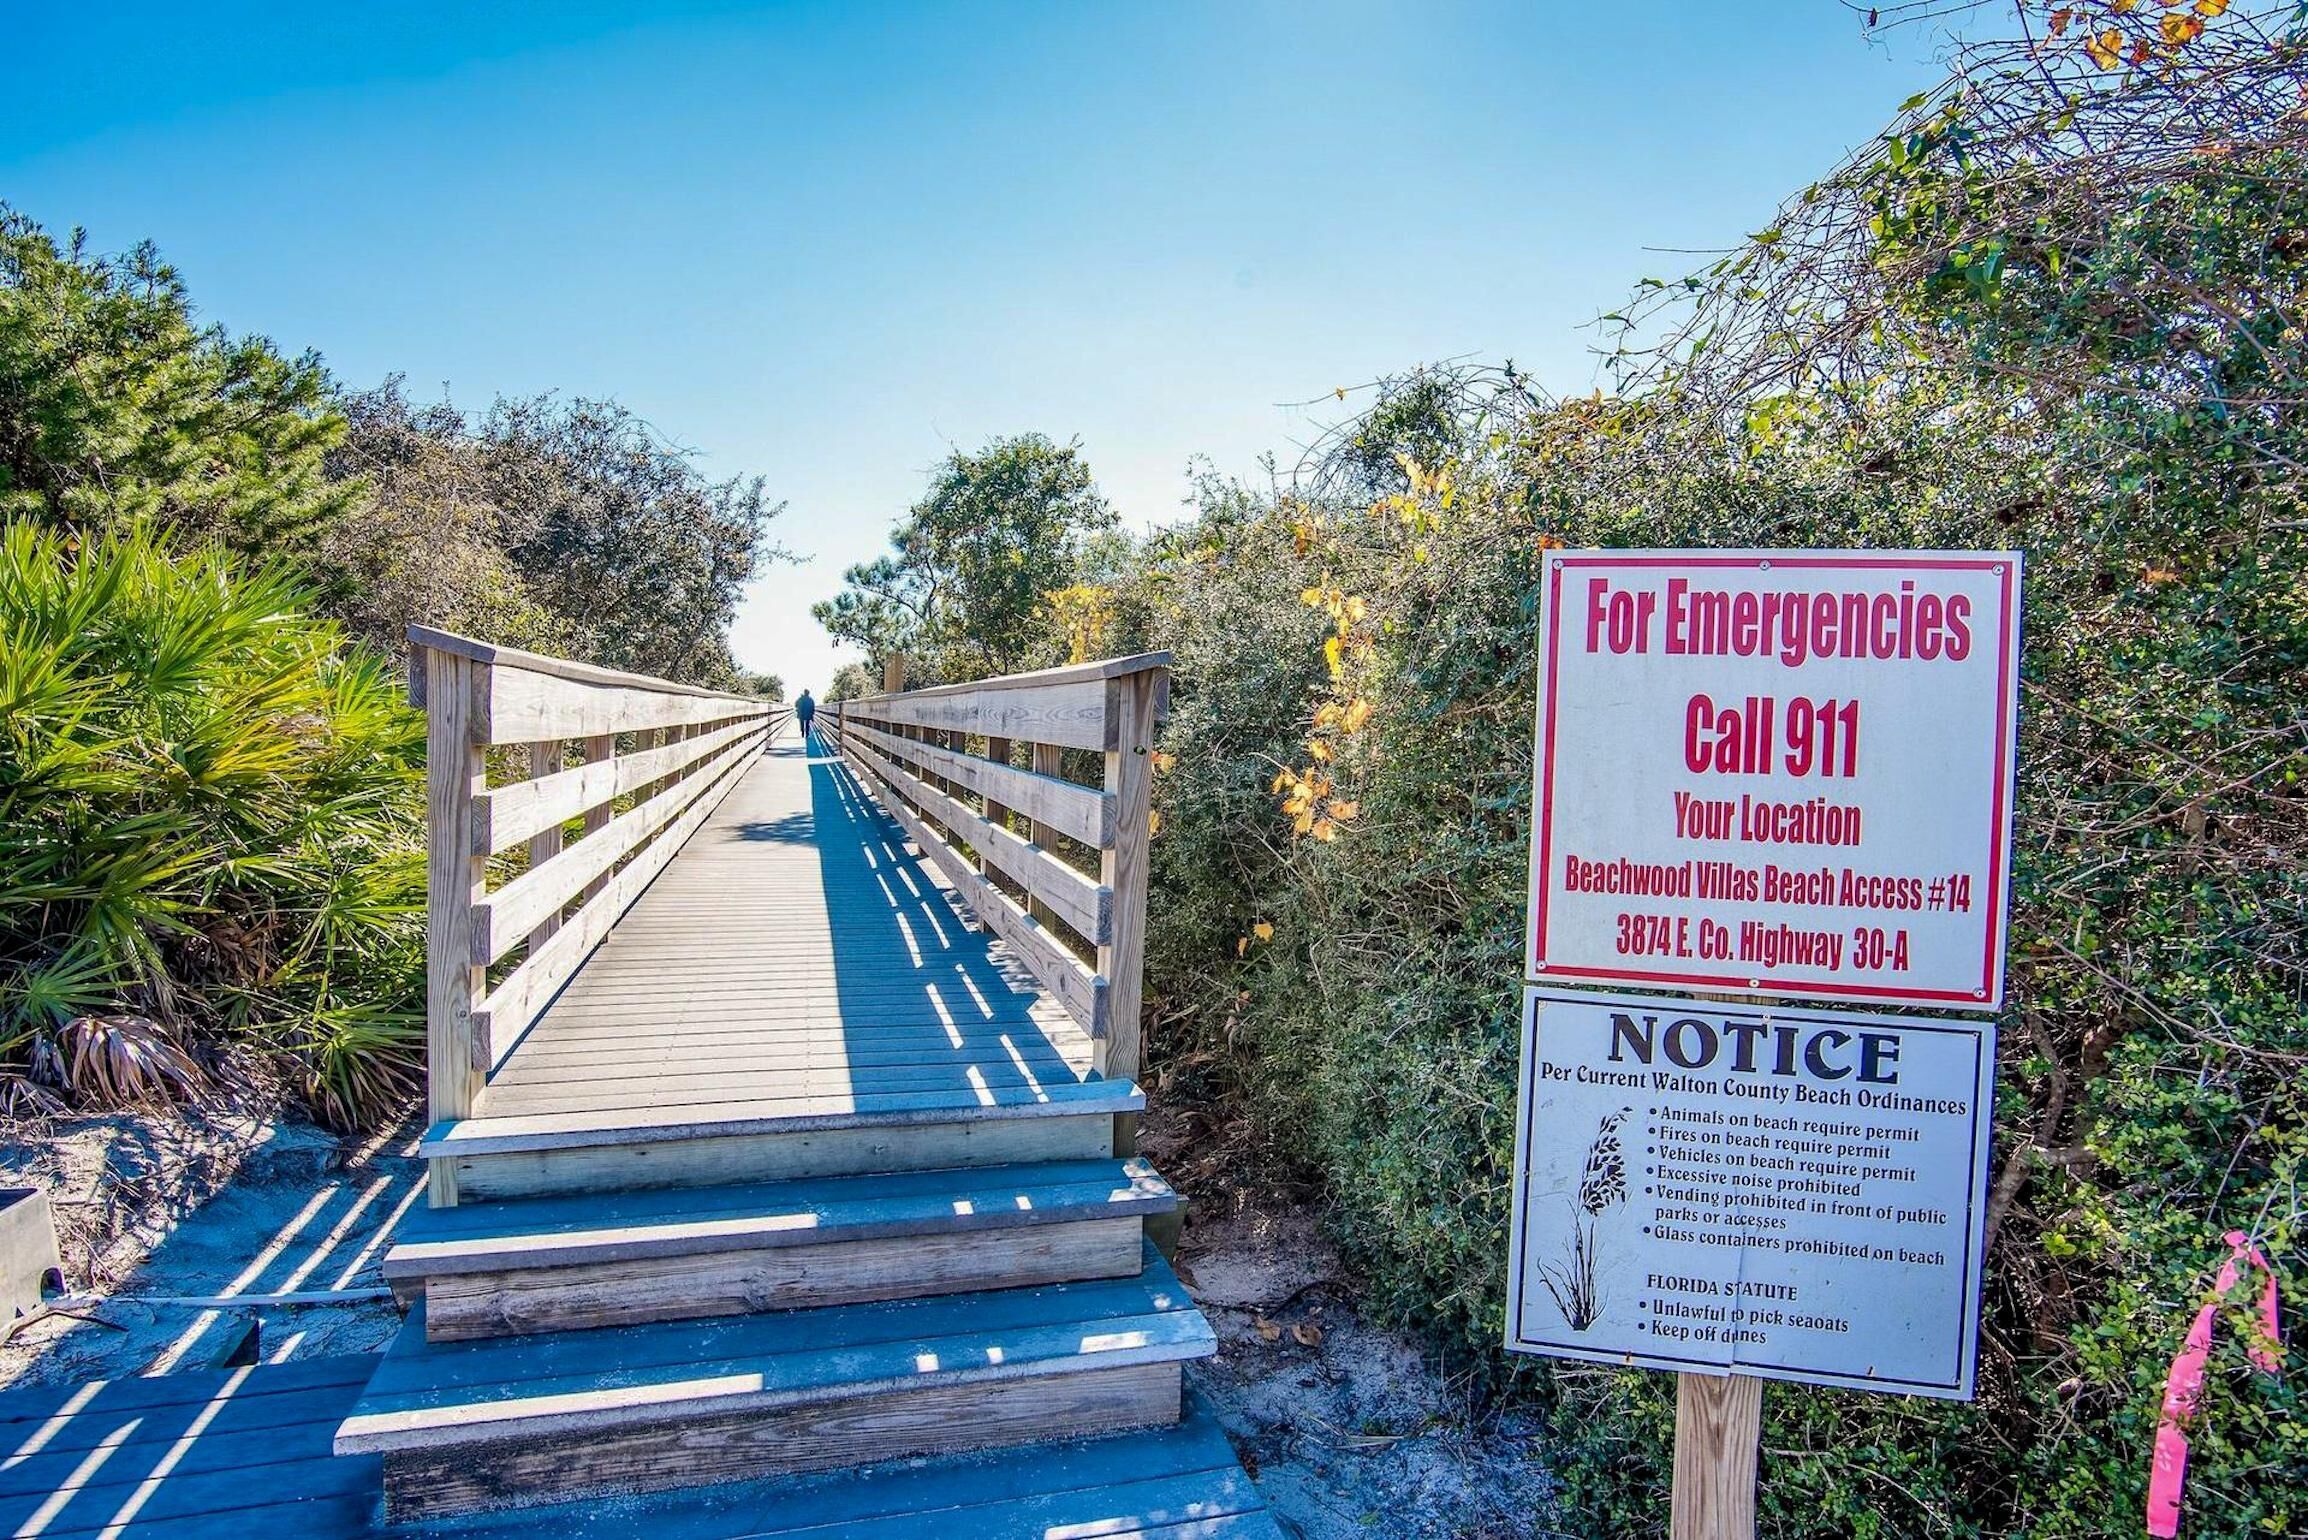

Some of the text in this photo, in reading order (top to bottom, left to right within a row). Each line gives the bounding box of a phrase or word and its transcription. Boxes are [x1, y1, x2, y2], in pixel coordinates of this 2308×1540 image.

[1586, 578, 1971, 667] For Emergencies
[1684, 694, 1859, 777] Call 911
[1674, 791, 1861, 846] Your Location
[1565, 855, 1971, 912] Beachwood Villas Beach Access #14
[1616, 914, 1909, 970] 3874 E. Co. Highway 30-A
[1608, 1013, 1901, 1084] NOTICE
[1541, 1062, 1967, 1115] Per Current Walton County Beach Ordinances
[1660, 1127, 1891, 1159] Fires on beach require permit
[1661, 1107, 1919, 1143] Animals on beach require permit
[1657, 1165, 1861, 1196] Excessive noise prohibited
[1659, 1146, 1917, 1182] Vehicles on beach require permit
[1655, 1205, 1787, 1230] parks or accesses
[1656, 1185, 1947, 1225] Vending prohibited in front of public
[1655, 1225, 1945, 1266] Glass containers prohibited on beach
[1647, 1274, 1719, 1295] FLORIDA
[1651, 1319, 1690, 1341] Keep
[1694, 1323, 1716, 1339] off
[1653, 1300, 1726, 1322] Unlawful
[1749, 1308, 1784, 1329] pick
[1787, 1312, 1849, 1333] seaoats
